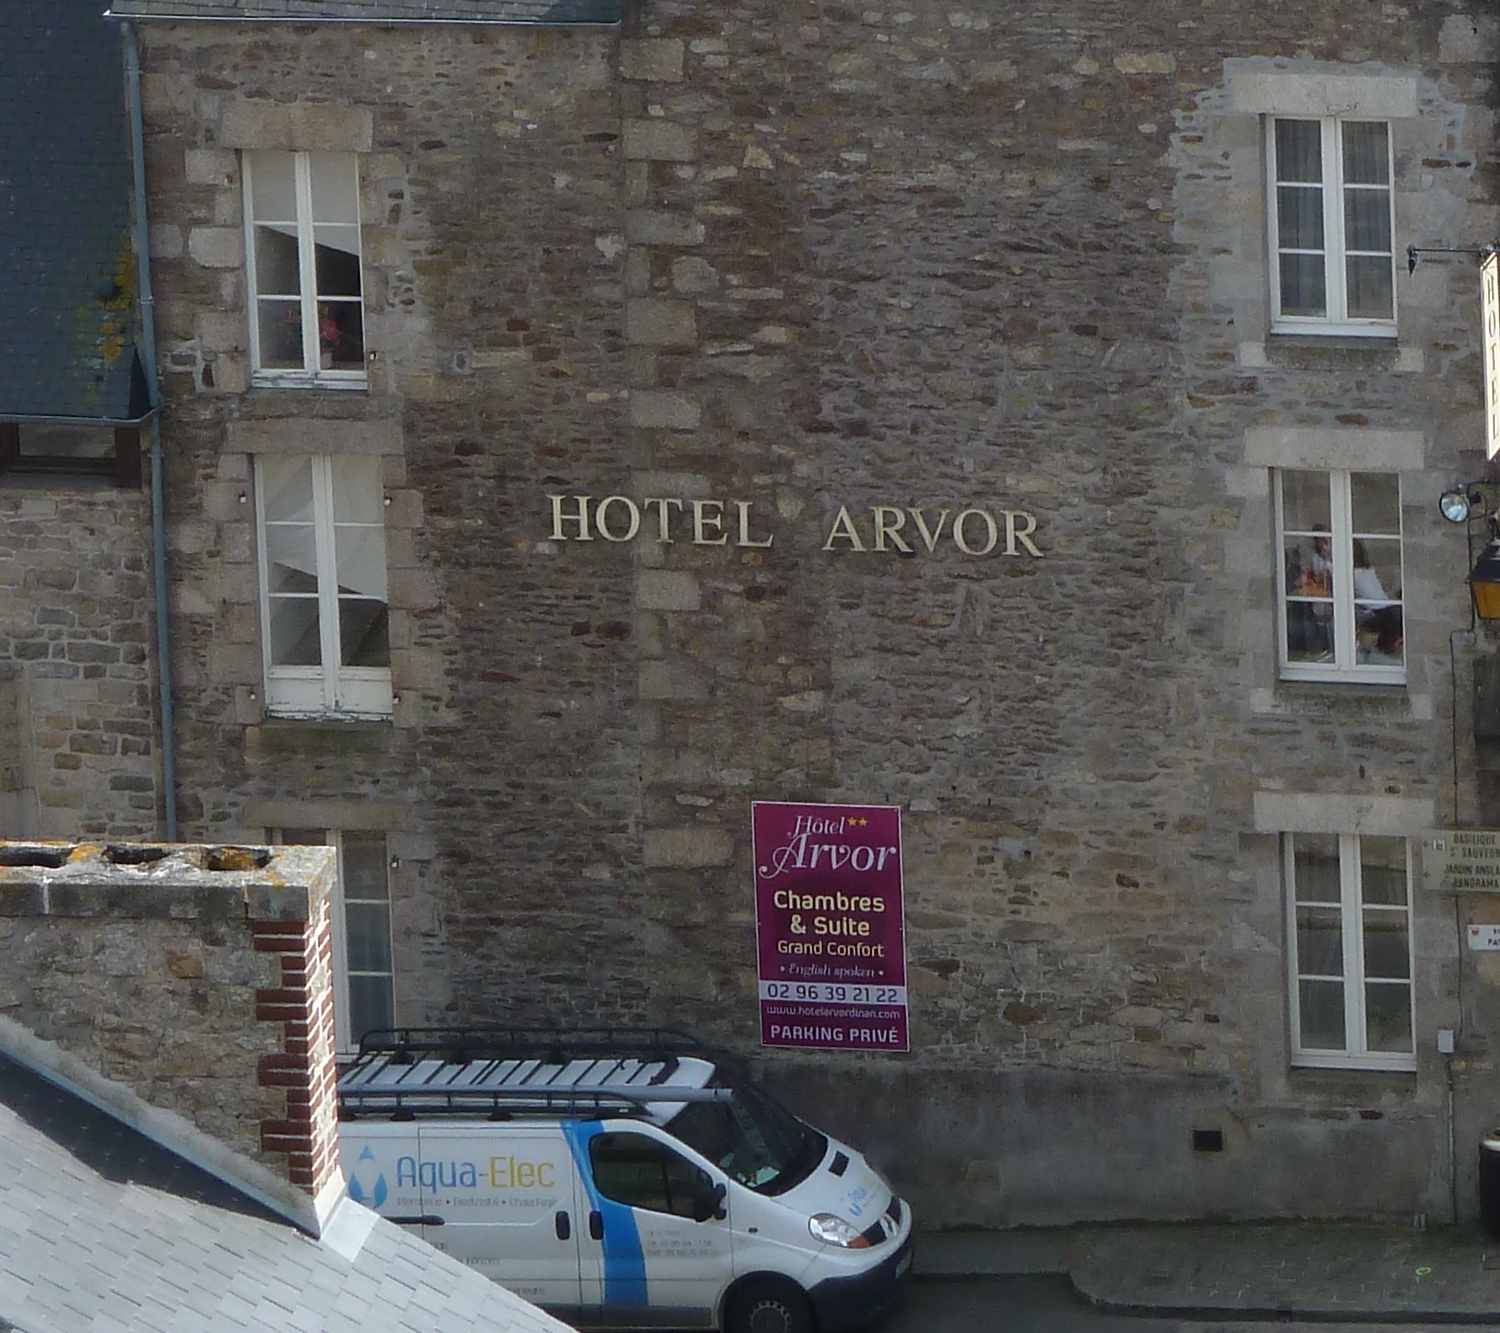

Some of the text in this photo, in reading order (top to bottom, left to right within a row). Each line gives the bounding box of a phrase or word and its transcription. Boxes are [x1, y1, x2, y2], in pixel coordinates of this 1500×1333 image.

[1486, 275, 1500, 440] HOTEL
[546, 492, 1045, 558] HOTEL ARVOR
[787, 814, 845, 838] Hôtel
[1453, 834, 1497, 845] BASILIQUE
[758, 831, 897, 880] Arvor
[1444, 863, 1473, 875] JARDIN
[1451, 876, 1500, 889] PANORAMA
[773, 889, 886, 913] Chambres
[789, 914, 871, 937] & Suite
[777, 939, 885, 958] Grand Confort
[767, 983, 898, 1003] 02 96 39 21 22
[770, 1024, 900, 1043] PARKING PRIVÉ
[396, 1154, 556, 1194] Aqua-Elec
